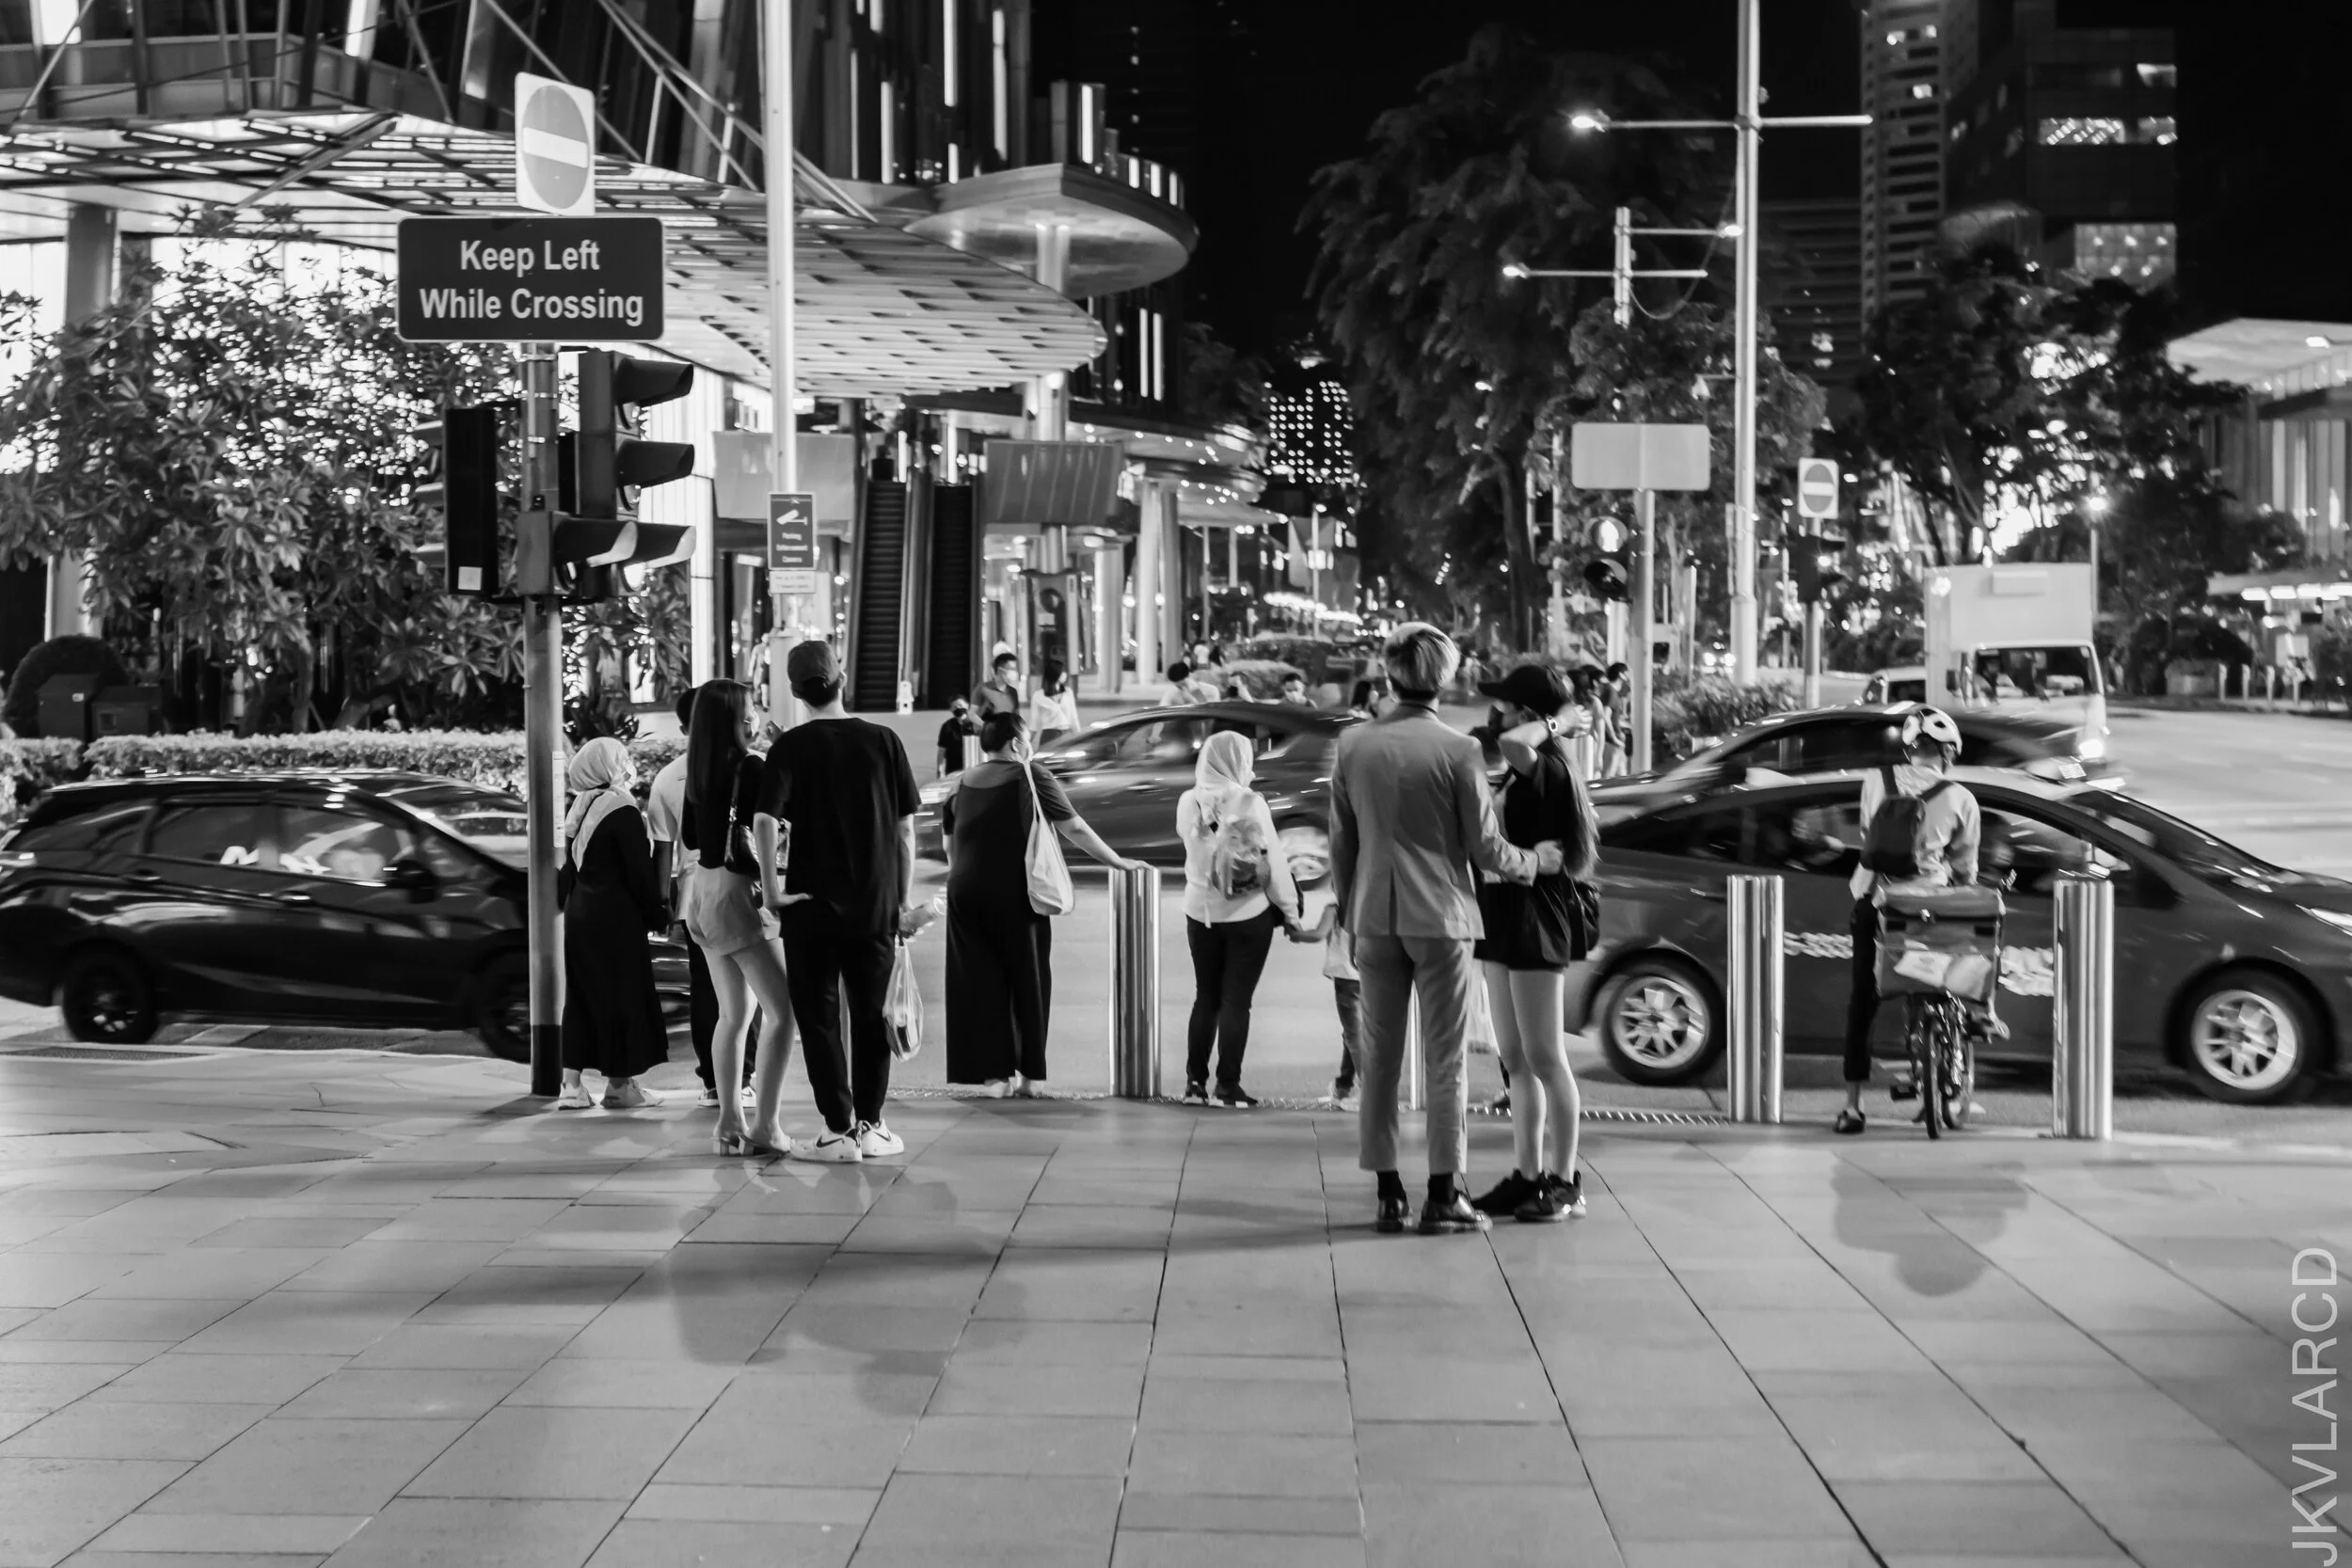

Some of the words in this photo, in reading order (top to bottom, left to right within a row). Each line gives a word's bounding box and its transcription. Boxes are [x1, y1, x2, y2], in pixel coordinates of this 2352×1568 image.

[460, 240, 535, 278] Keep
[544, 239, 600, 271] Left
[419, 288, 501, 319] While
[510, 287, 644, 327] Crossing
